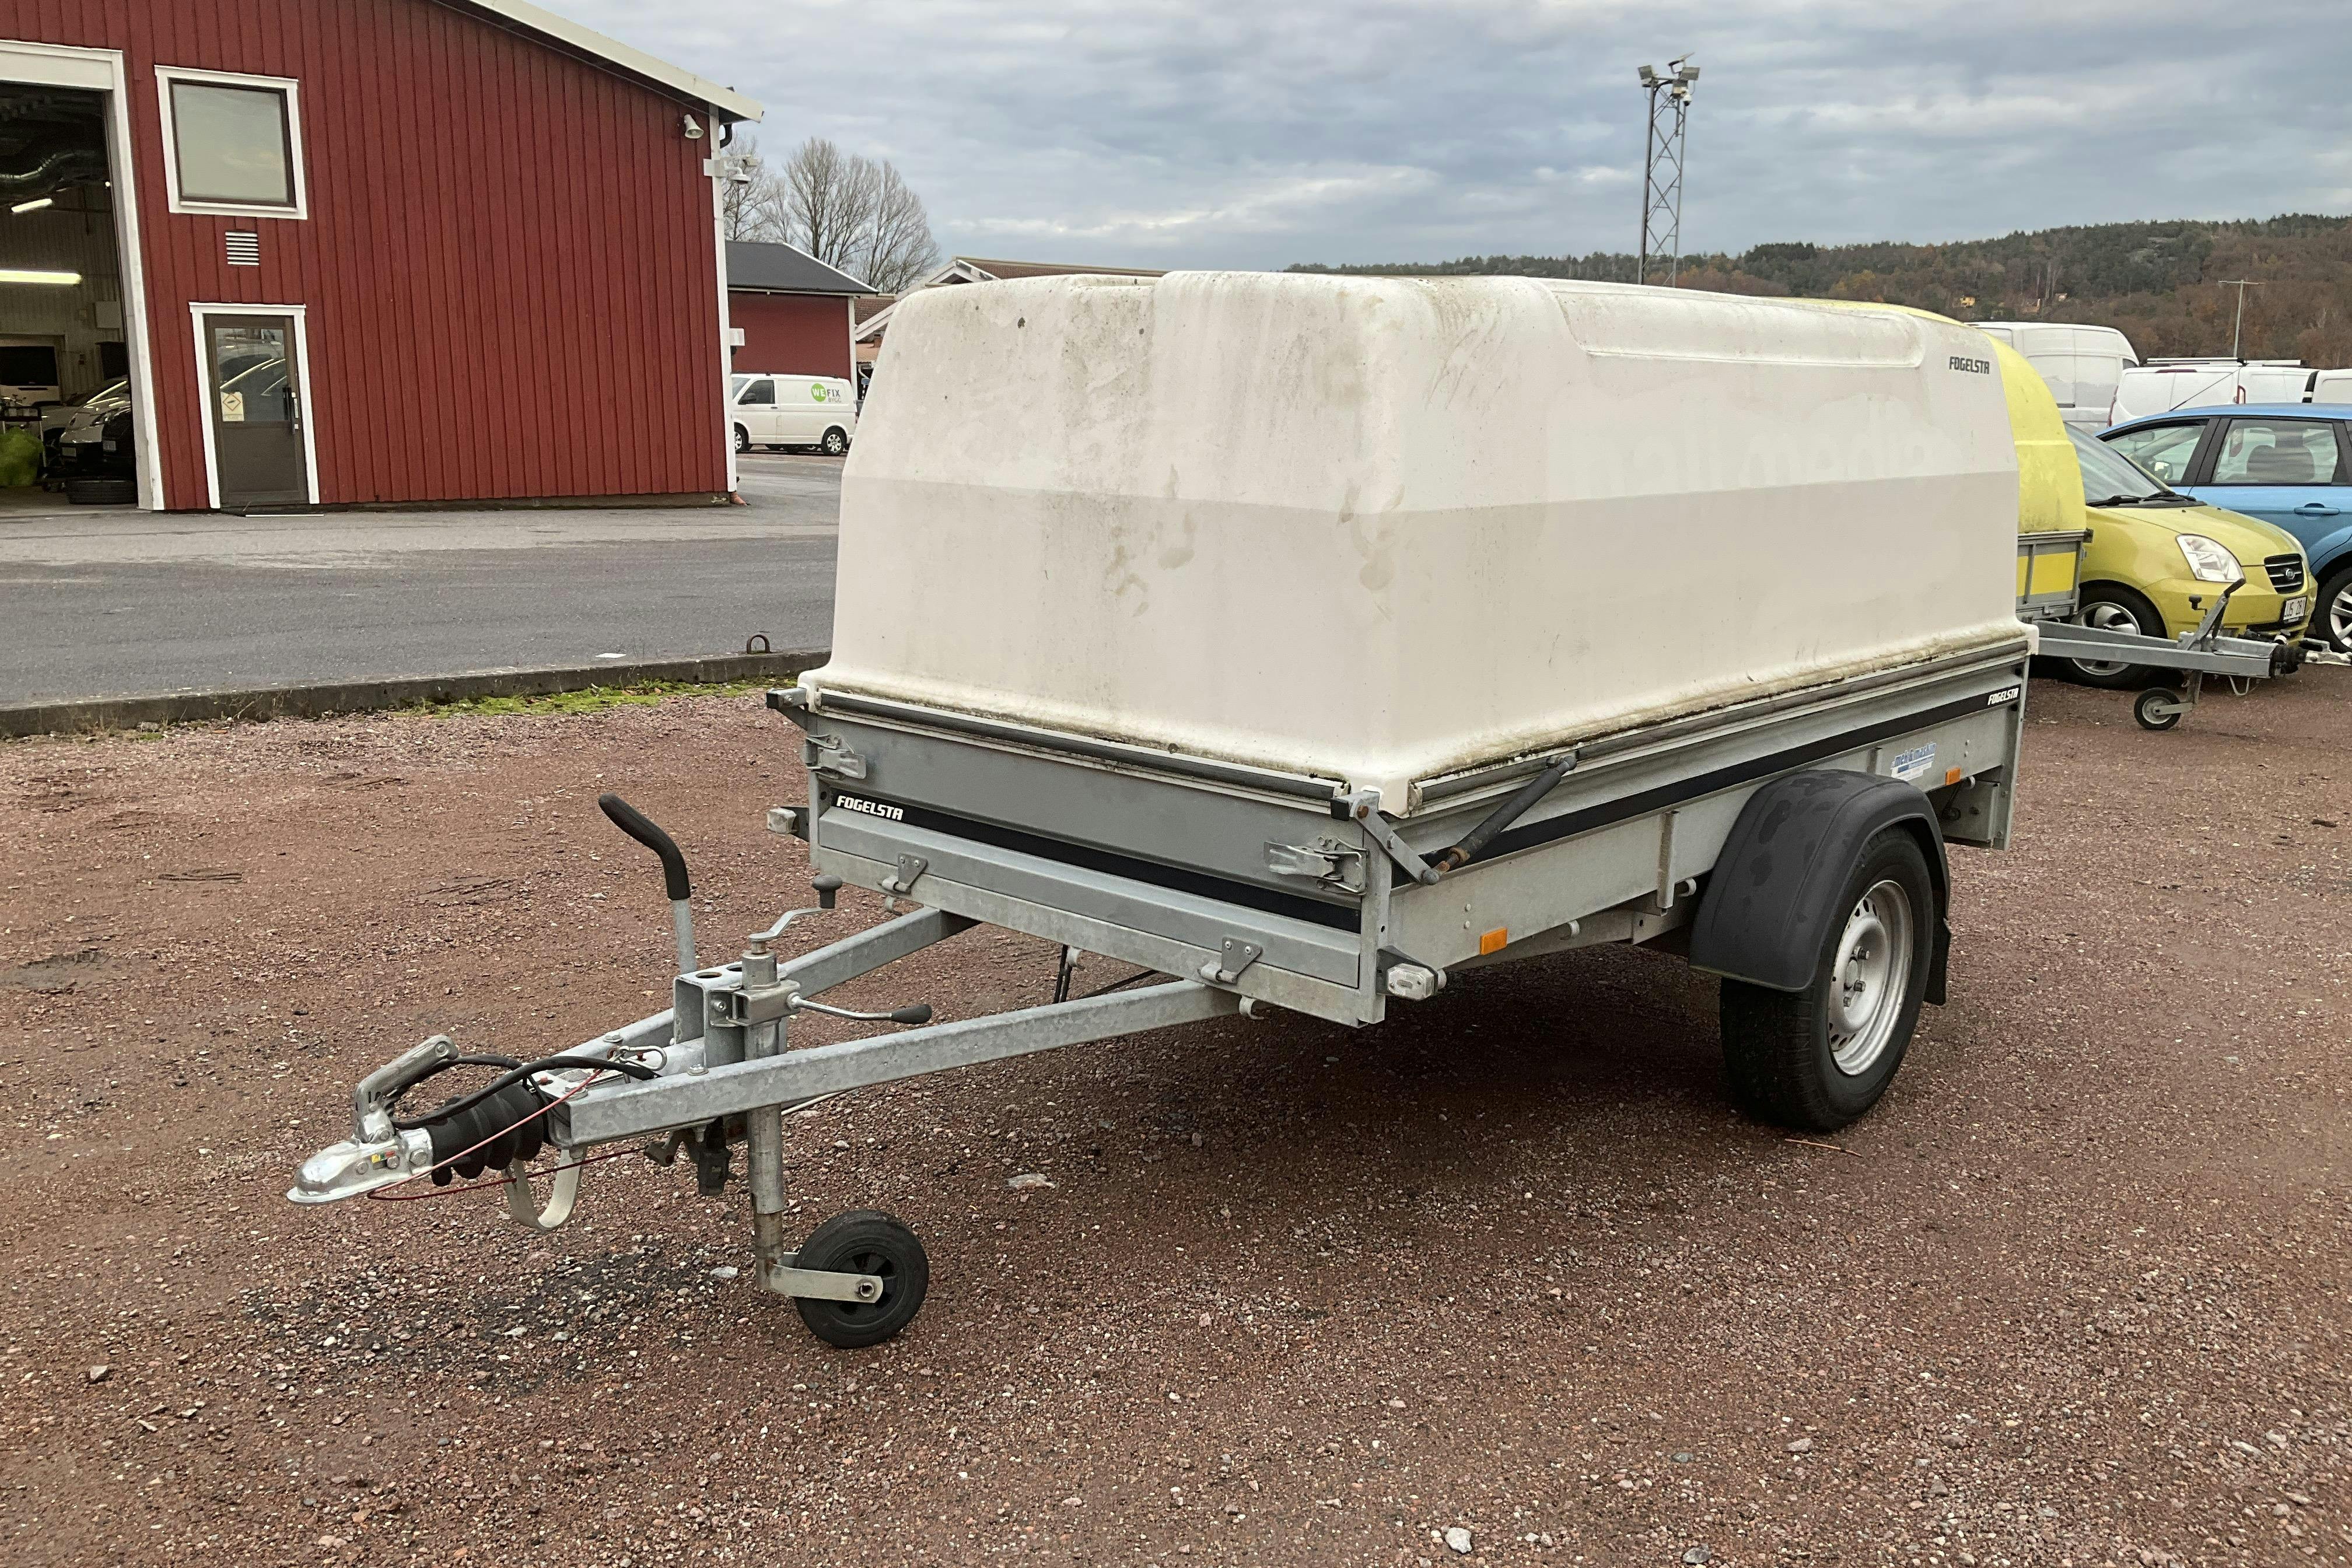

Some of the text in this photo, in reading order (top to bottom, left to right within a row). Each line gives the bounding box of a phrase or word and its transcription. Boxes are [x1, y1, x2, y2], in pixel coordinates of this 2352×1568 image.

[1949, 356, 1990, 374] FOGELSTA
[812, 388, 841, 397] WE FIX
[1987, 687, 2019, 705] FOGELSTA
[836, 795, 904, 821] FOGELSTA
